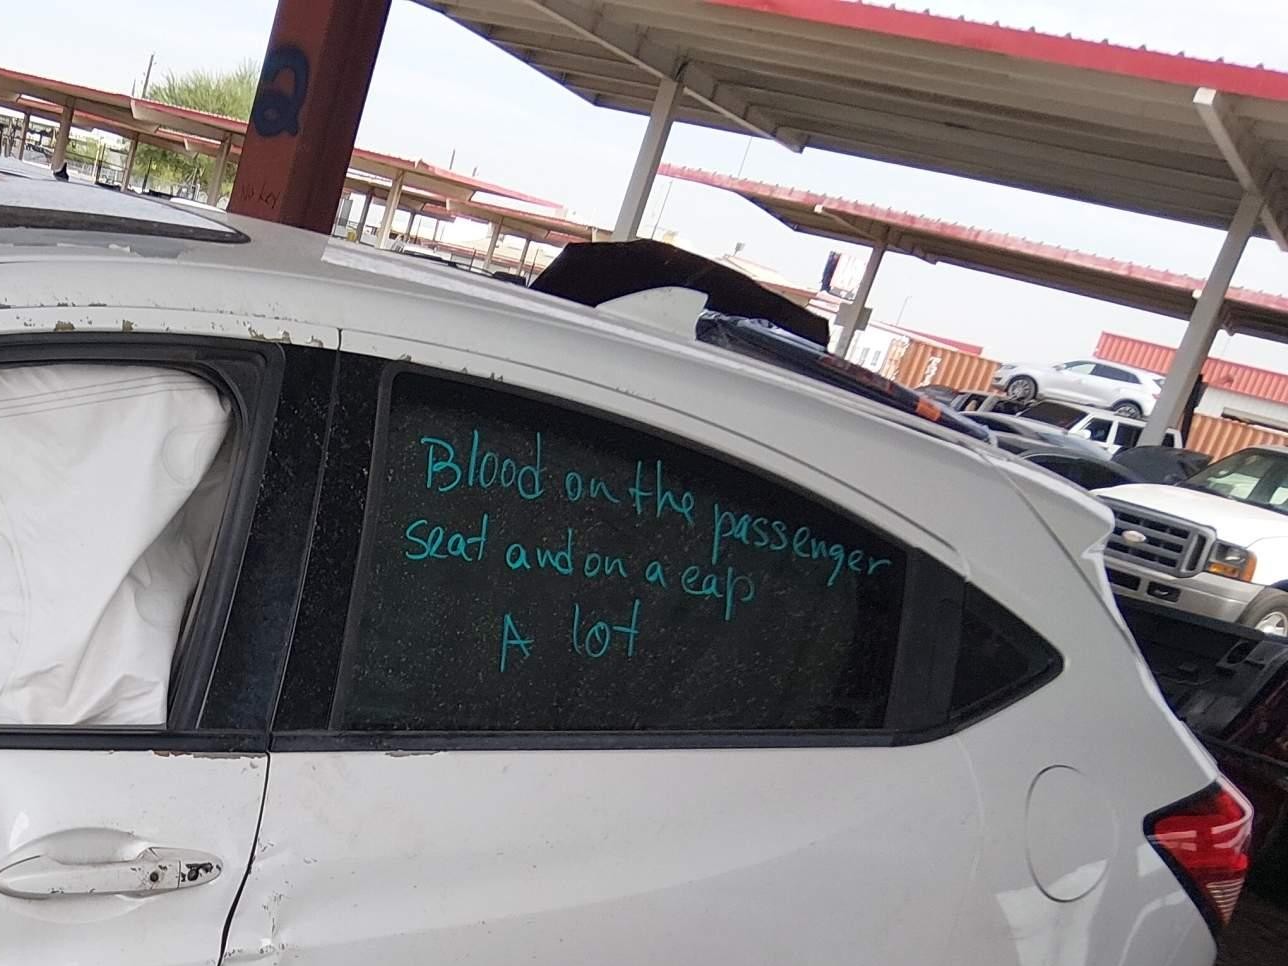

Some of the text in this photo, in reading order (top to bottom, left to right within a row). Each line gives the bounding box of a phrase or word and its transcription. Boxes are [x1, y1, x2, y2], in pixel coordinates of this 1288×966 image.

[419, 430, 894, 587] Blood on the passenger
[505, 527, 574, 576] and
[584, 551, 629, 578] on
[645, 560, 668, 589] a
[498, 599, 642, 673] A lot
